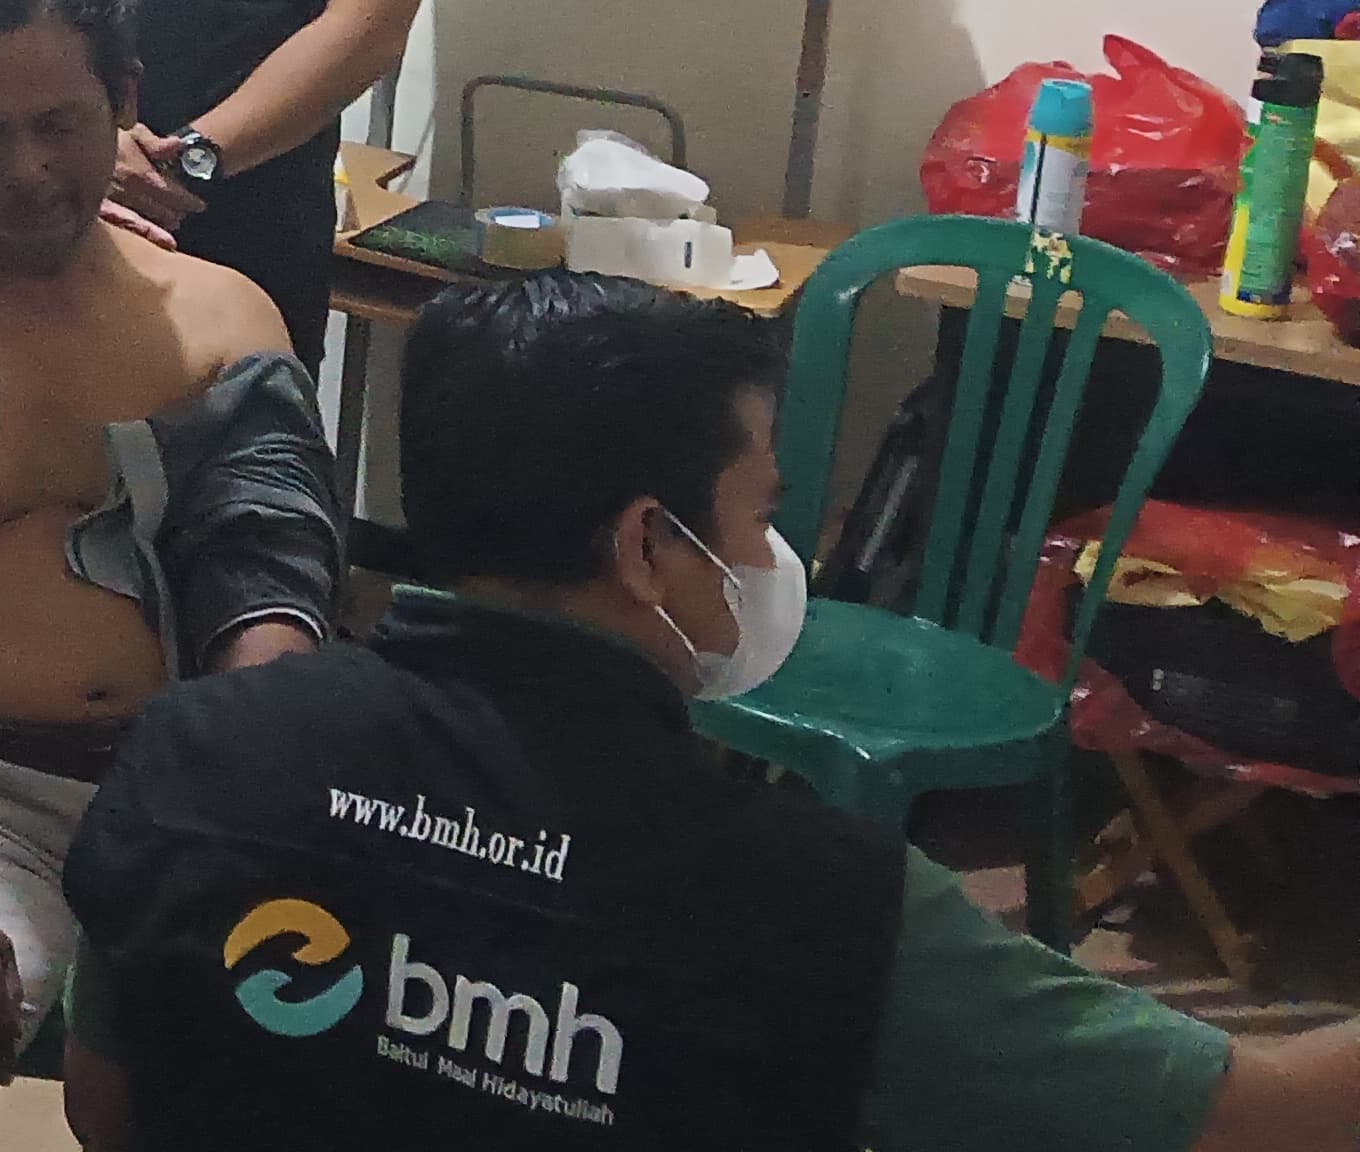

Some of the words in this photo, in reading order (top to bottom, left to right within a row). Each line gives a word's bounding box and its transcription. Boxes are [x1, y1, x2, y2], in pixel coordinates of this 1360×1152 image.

[329, 787, 571, 883] www.bmh.or.id
[386, 933, 624, 1095] bmh
[377, 1035, 429, 1070] Baitul
[437, 1055, 477, 1089] Maal
[480, 1071, 616, 1125] Hidayatullah
